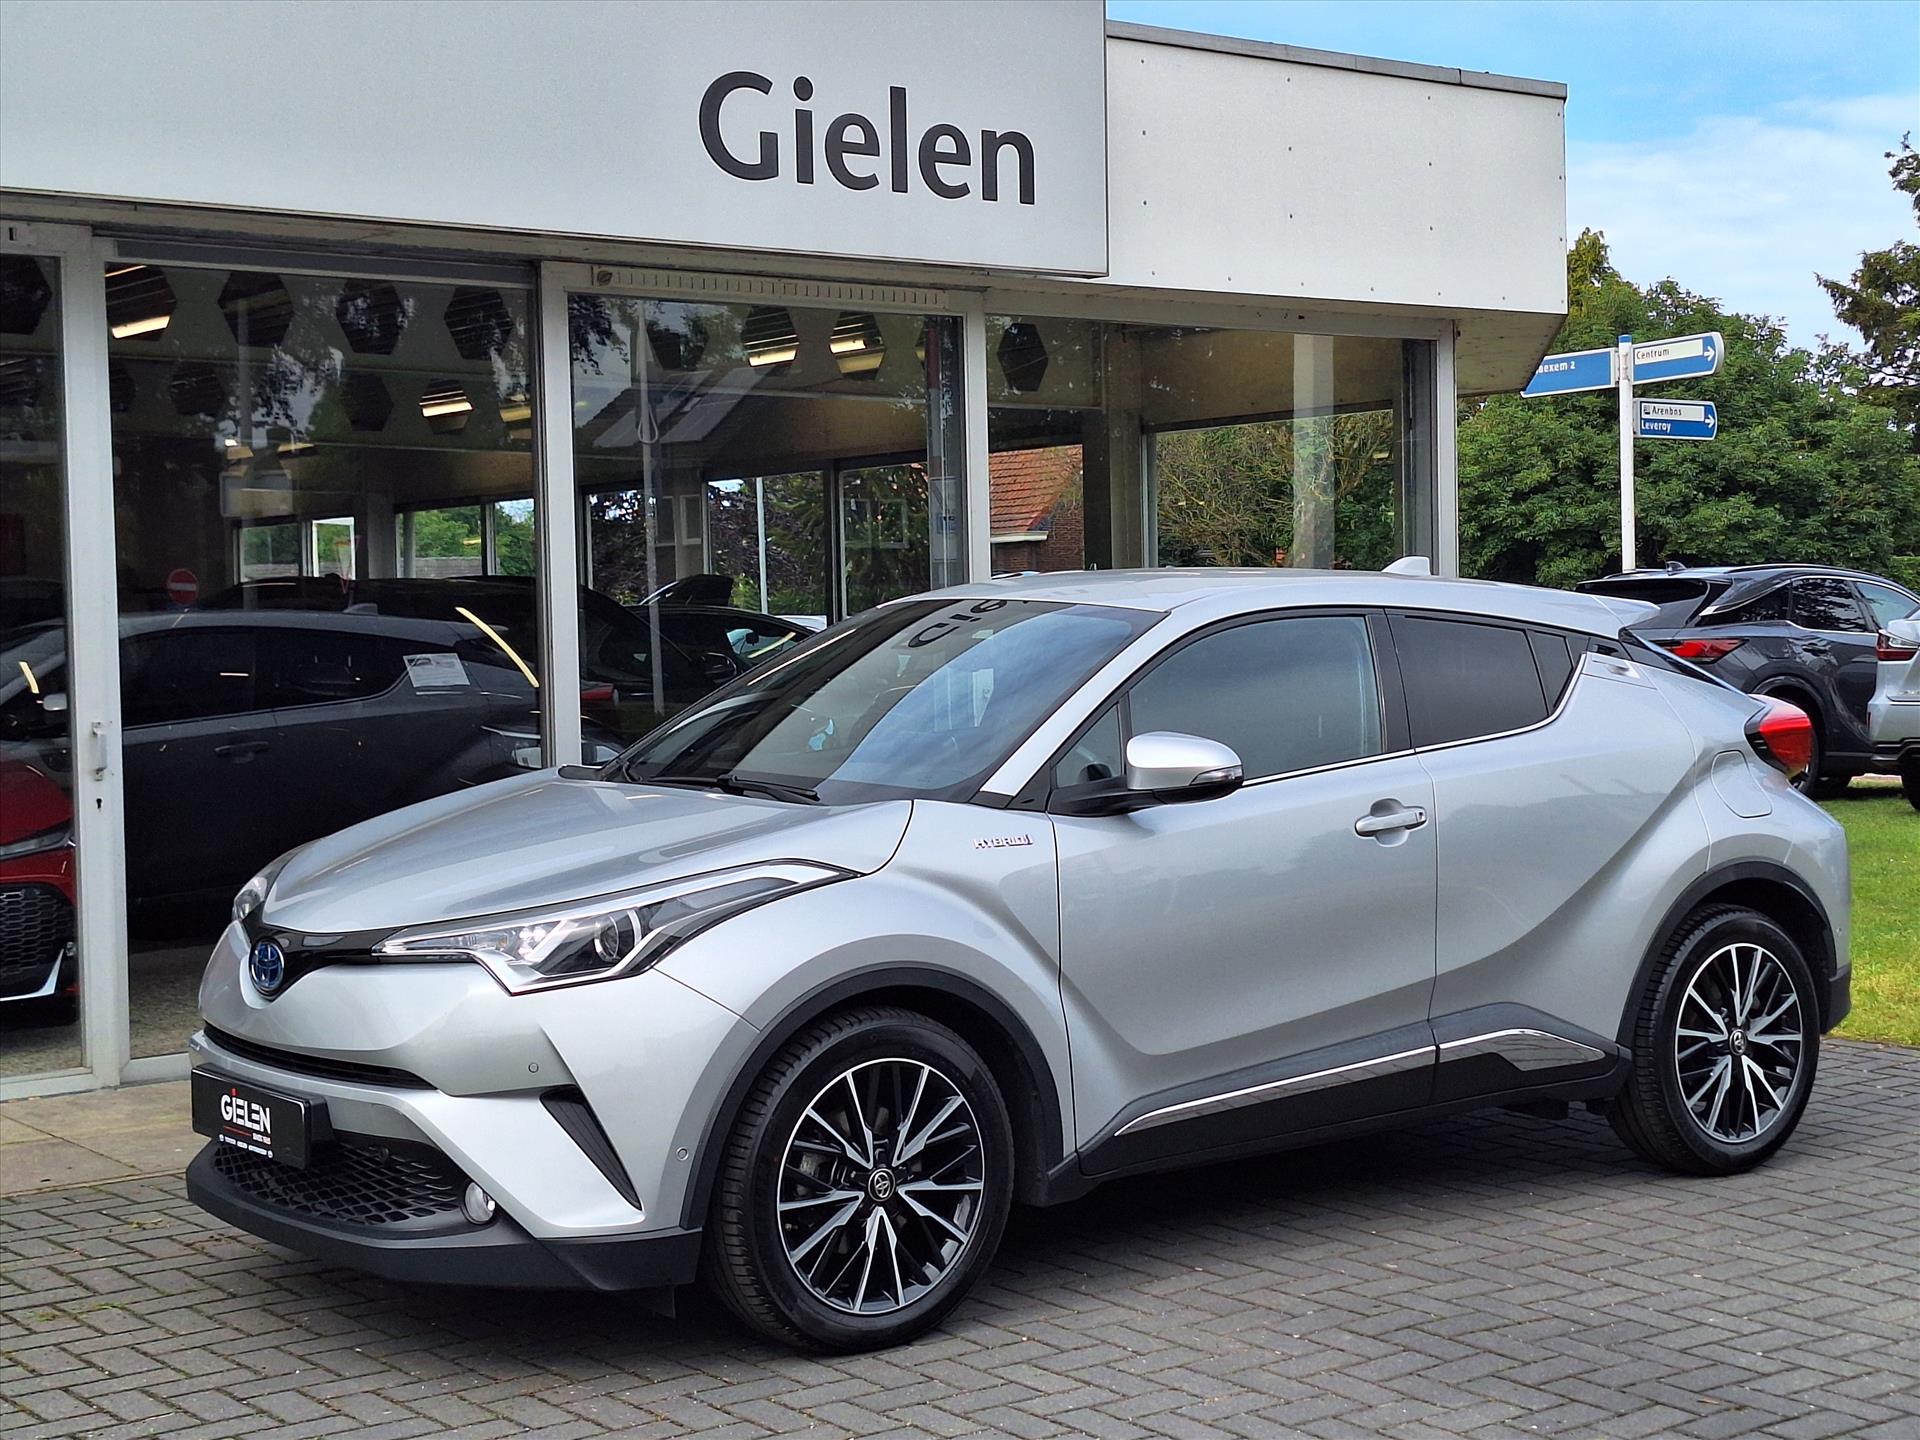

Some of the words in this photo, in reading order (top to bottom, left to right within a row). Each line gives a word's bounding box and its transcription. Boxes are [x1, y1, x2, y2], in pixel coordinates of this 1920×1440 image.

[699, 70, 1036, 205] Gielen
[1636, 349, 1670, 360] Centrum
[1536, 362, 1568, 374] aexem
[1570, 360, 1576, 370] 2
[1652, 405, 1682, 416] Arenbos
[1641, 419, 1671, 434] Leveroy
[974, 834, 1033, 849] HYBRID
